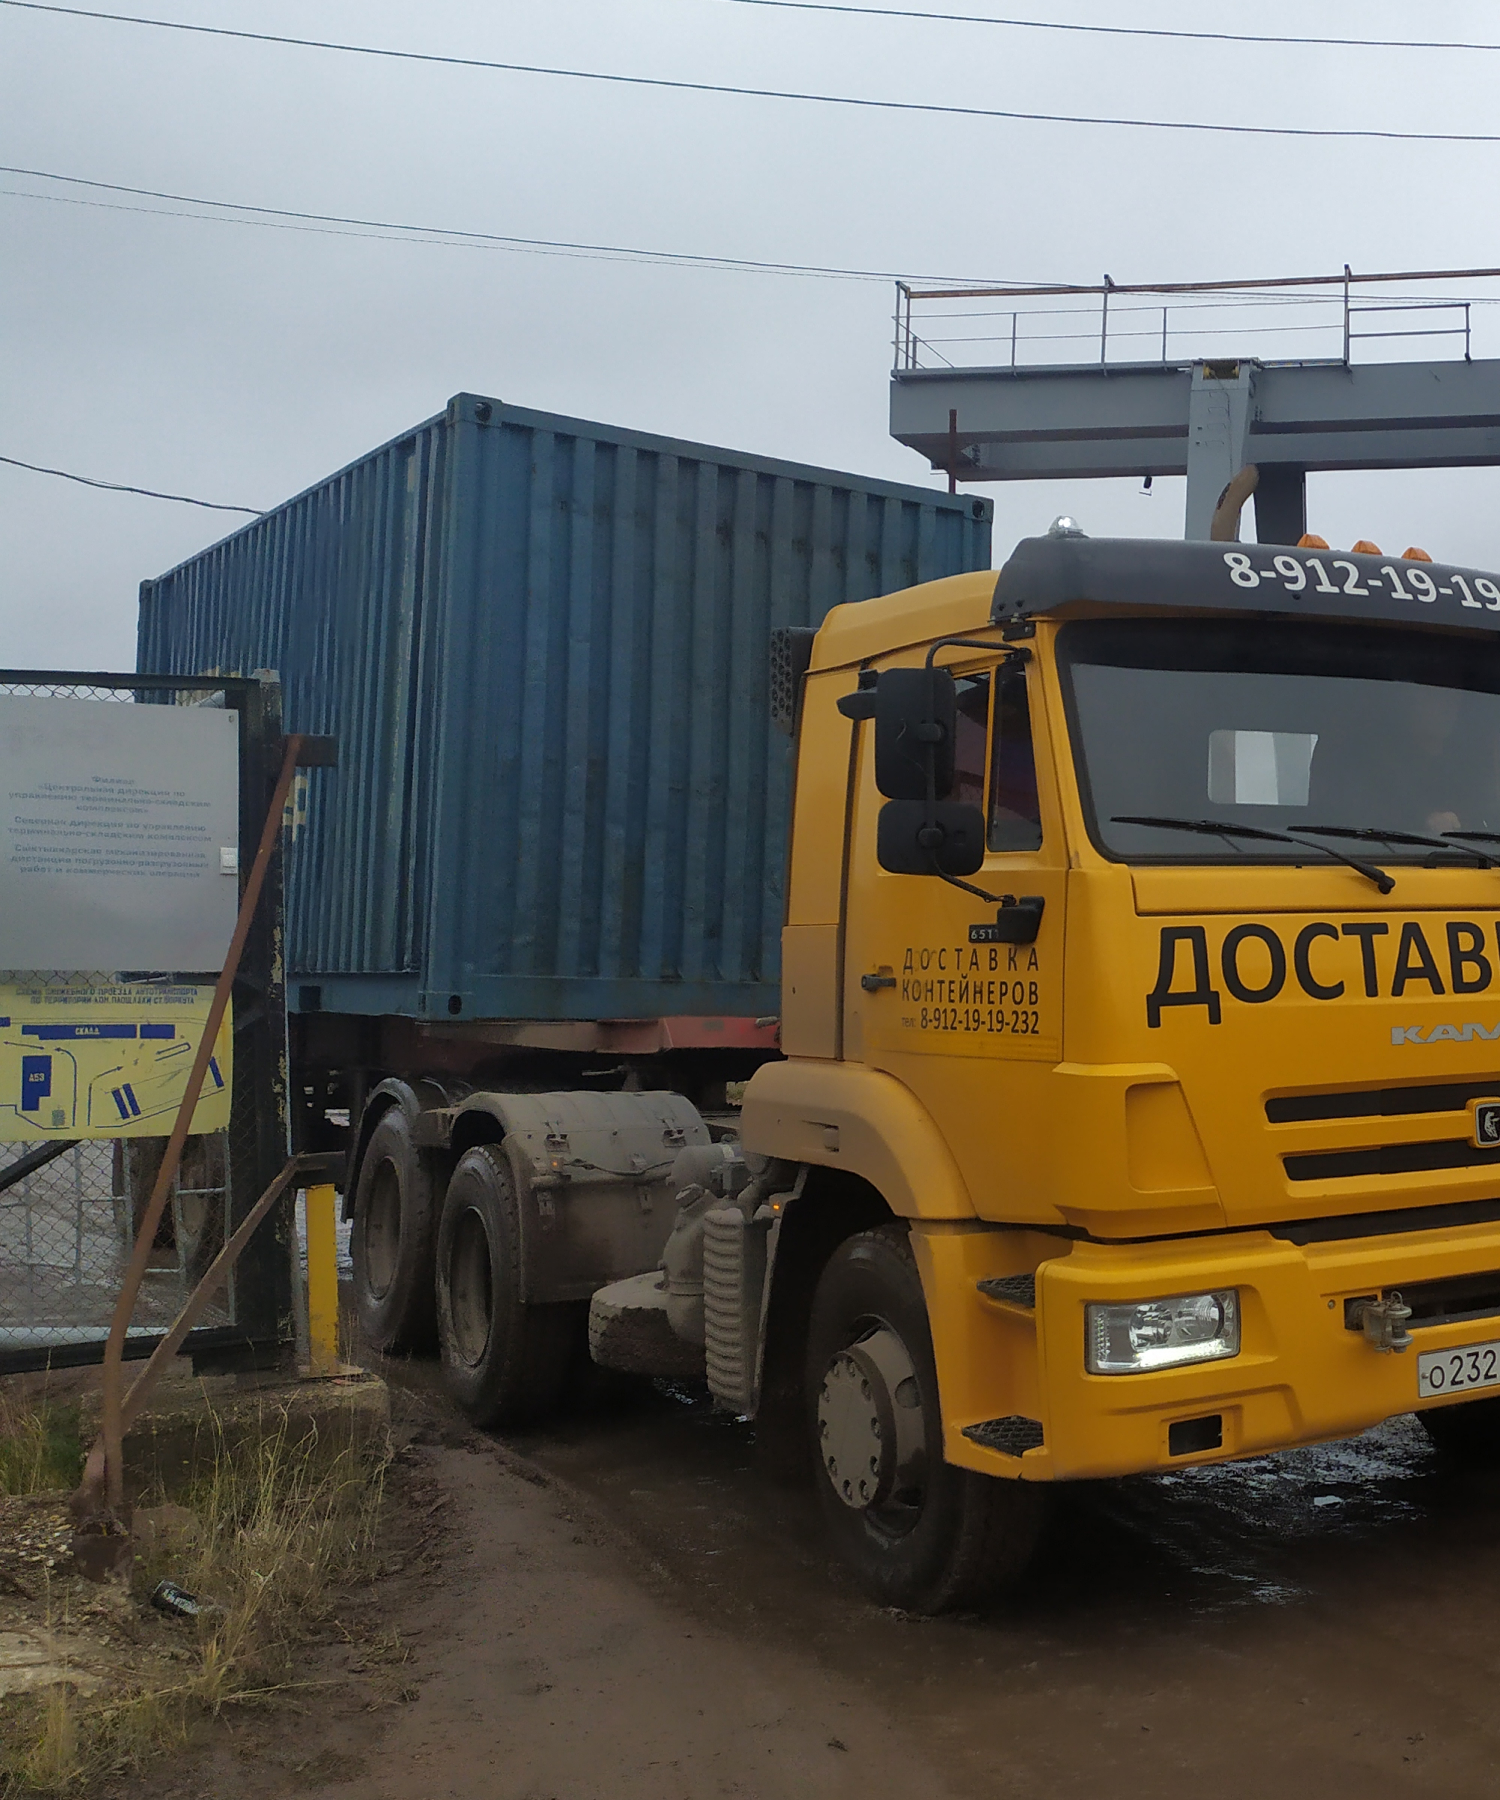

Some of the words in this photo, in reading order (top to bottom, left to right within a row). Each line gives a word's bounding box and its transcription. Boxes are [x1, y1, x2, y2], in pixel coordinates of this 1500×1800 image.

[902, 947, 1039, 975] ДОСТАВКА
[902, 973, 1039, 1006] КОНТЕЙНЕРОВ
[920, 1007, 1040, 1035] 8-912-19-19-232
